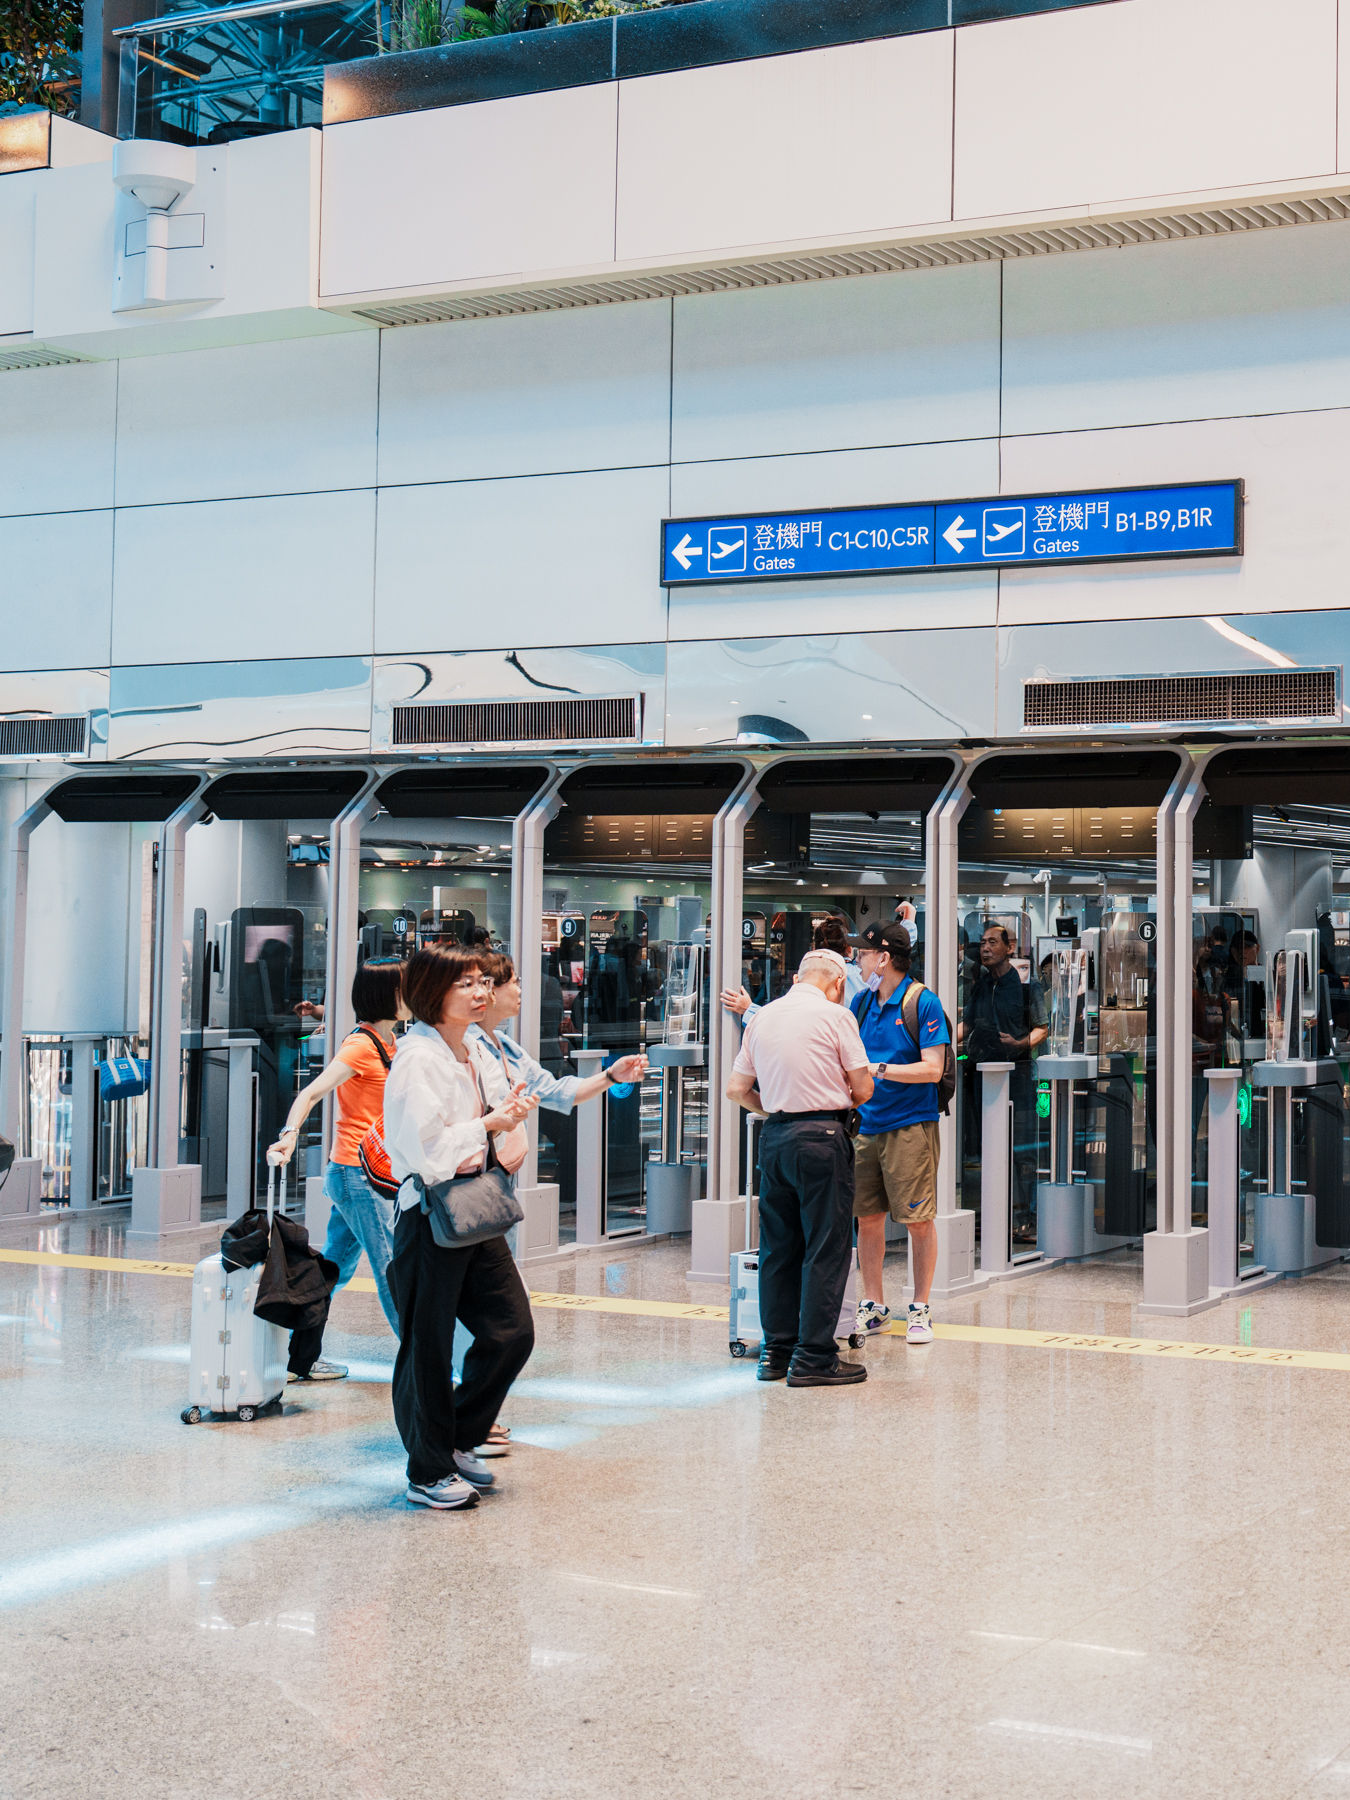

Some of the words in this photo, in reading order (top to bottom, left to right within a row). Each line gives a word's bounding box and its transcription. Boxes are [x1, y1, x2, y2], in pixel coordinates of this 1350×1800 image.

[1033, 501, 1110, 533] 登機門
[1117, 507, 1213, 533] B1-B9,B1R
[753, 520, 822, 551] 登機門
[829, 526, 929, 552] C1-C10,C5R
[1034, 537, 1080, 555] Gates
[754, 555, 796, 572] Gates
